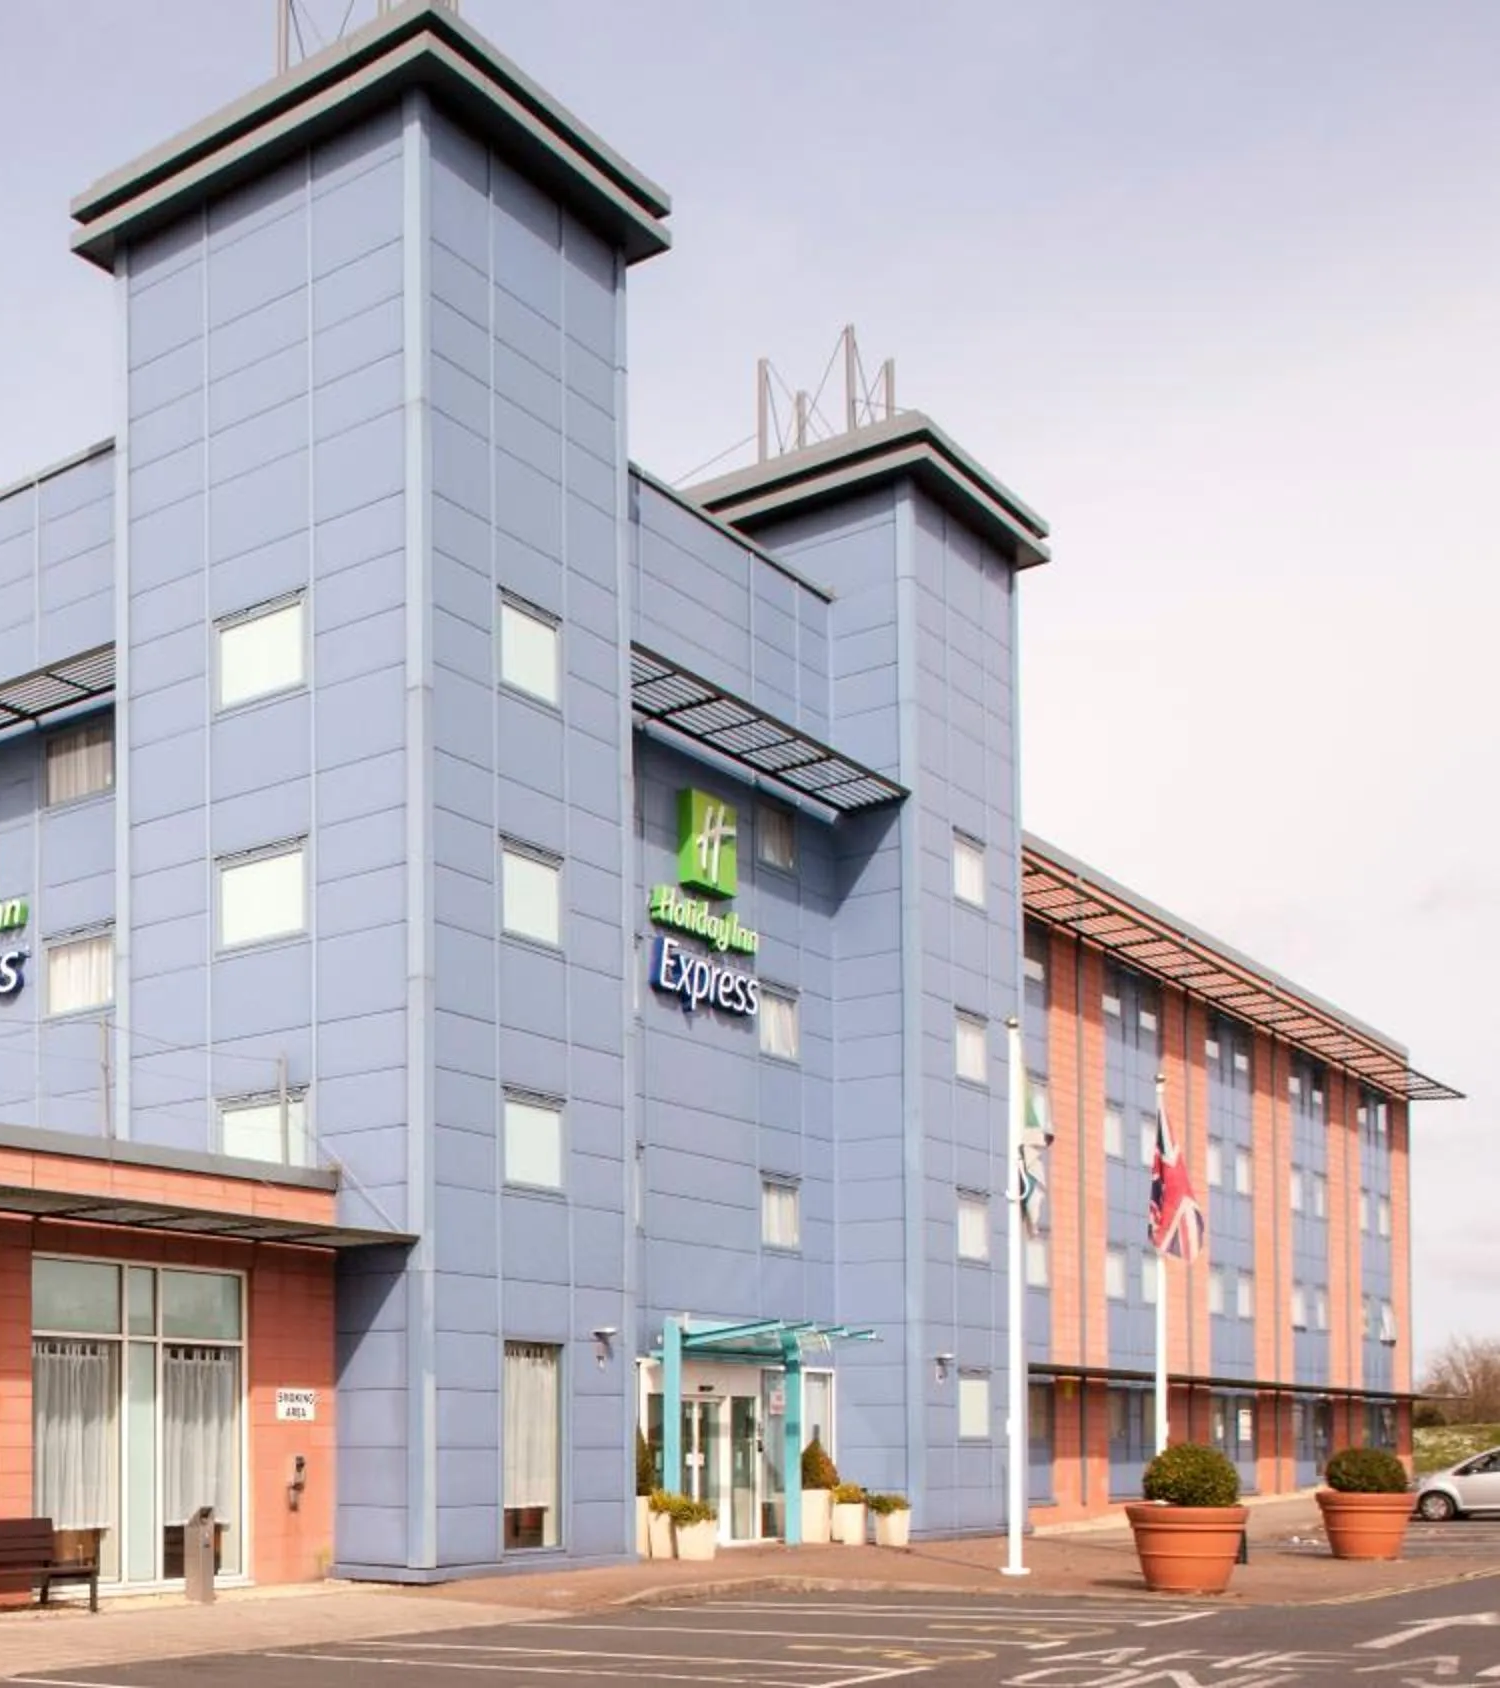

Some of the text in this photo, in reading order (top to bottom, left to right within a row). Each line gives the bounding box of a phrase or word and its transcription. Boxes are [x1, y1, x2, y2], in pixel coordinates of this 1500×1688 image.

[655, 886, 759, 952] Holiday Inn
[659, 937, 760, 1015] Express
[1030, 1647, 1500, 1676] AHEA
